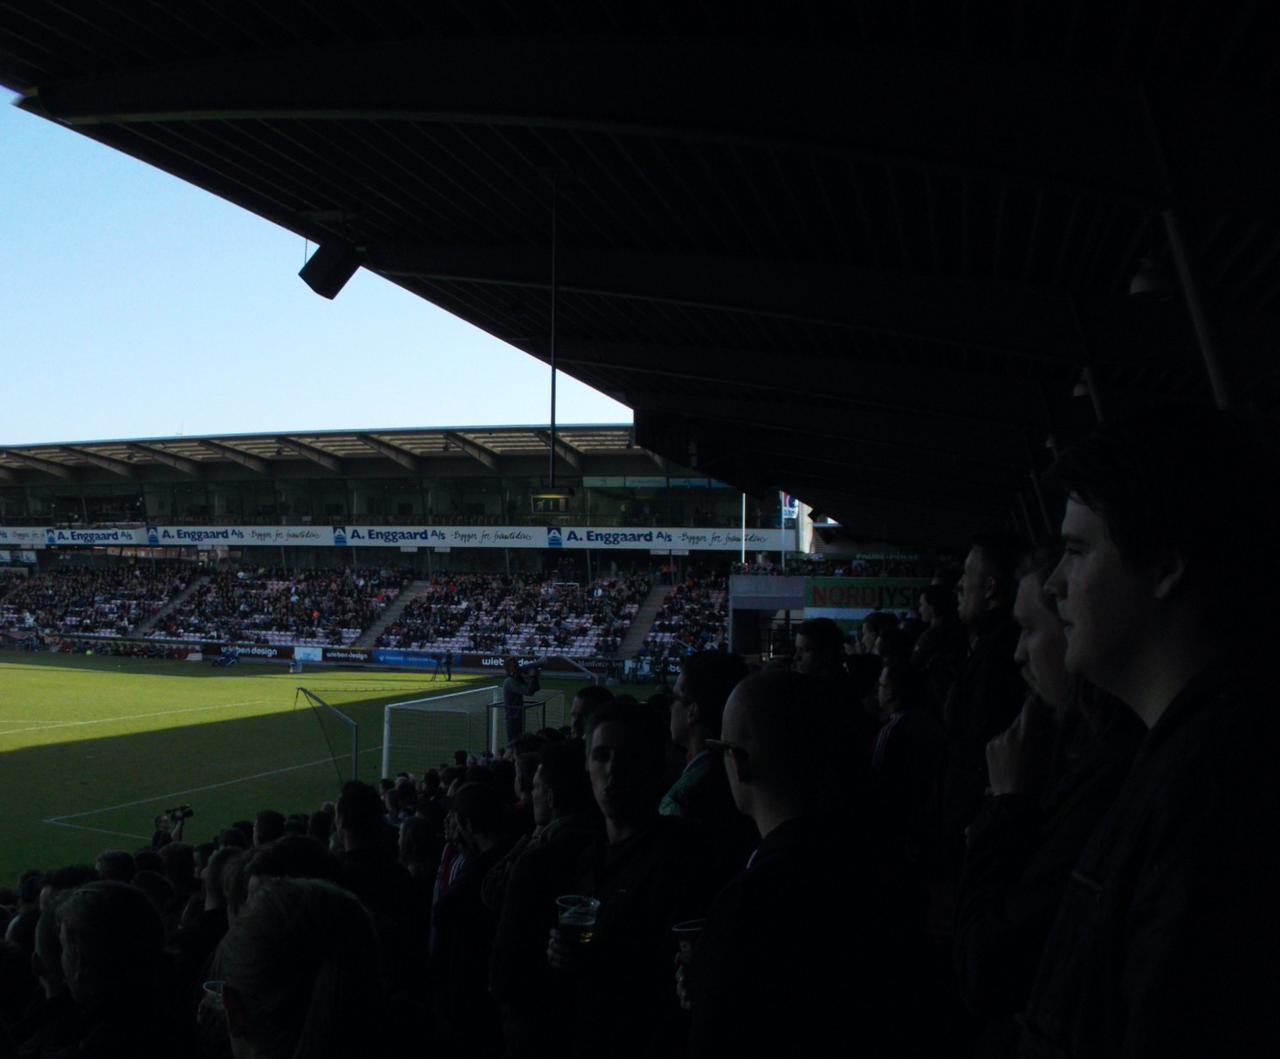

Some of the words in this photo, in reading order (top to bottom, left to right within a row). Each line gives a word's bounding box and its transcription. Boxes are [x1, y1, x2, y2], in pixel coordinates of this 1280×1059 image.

[57, 530, 69, 540] A.
[71, 530, 119, 543] Enggaard
[162, 529, 175, 539] A.
[177, 529, 229, 542] Enggaard
[351, 529, 365, 540] A.
[368, 529, 428, 543] Enggaard
[567, 531, 583, 541] A.
[586, 530, 653, 545] Enggaard
